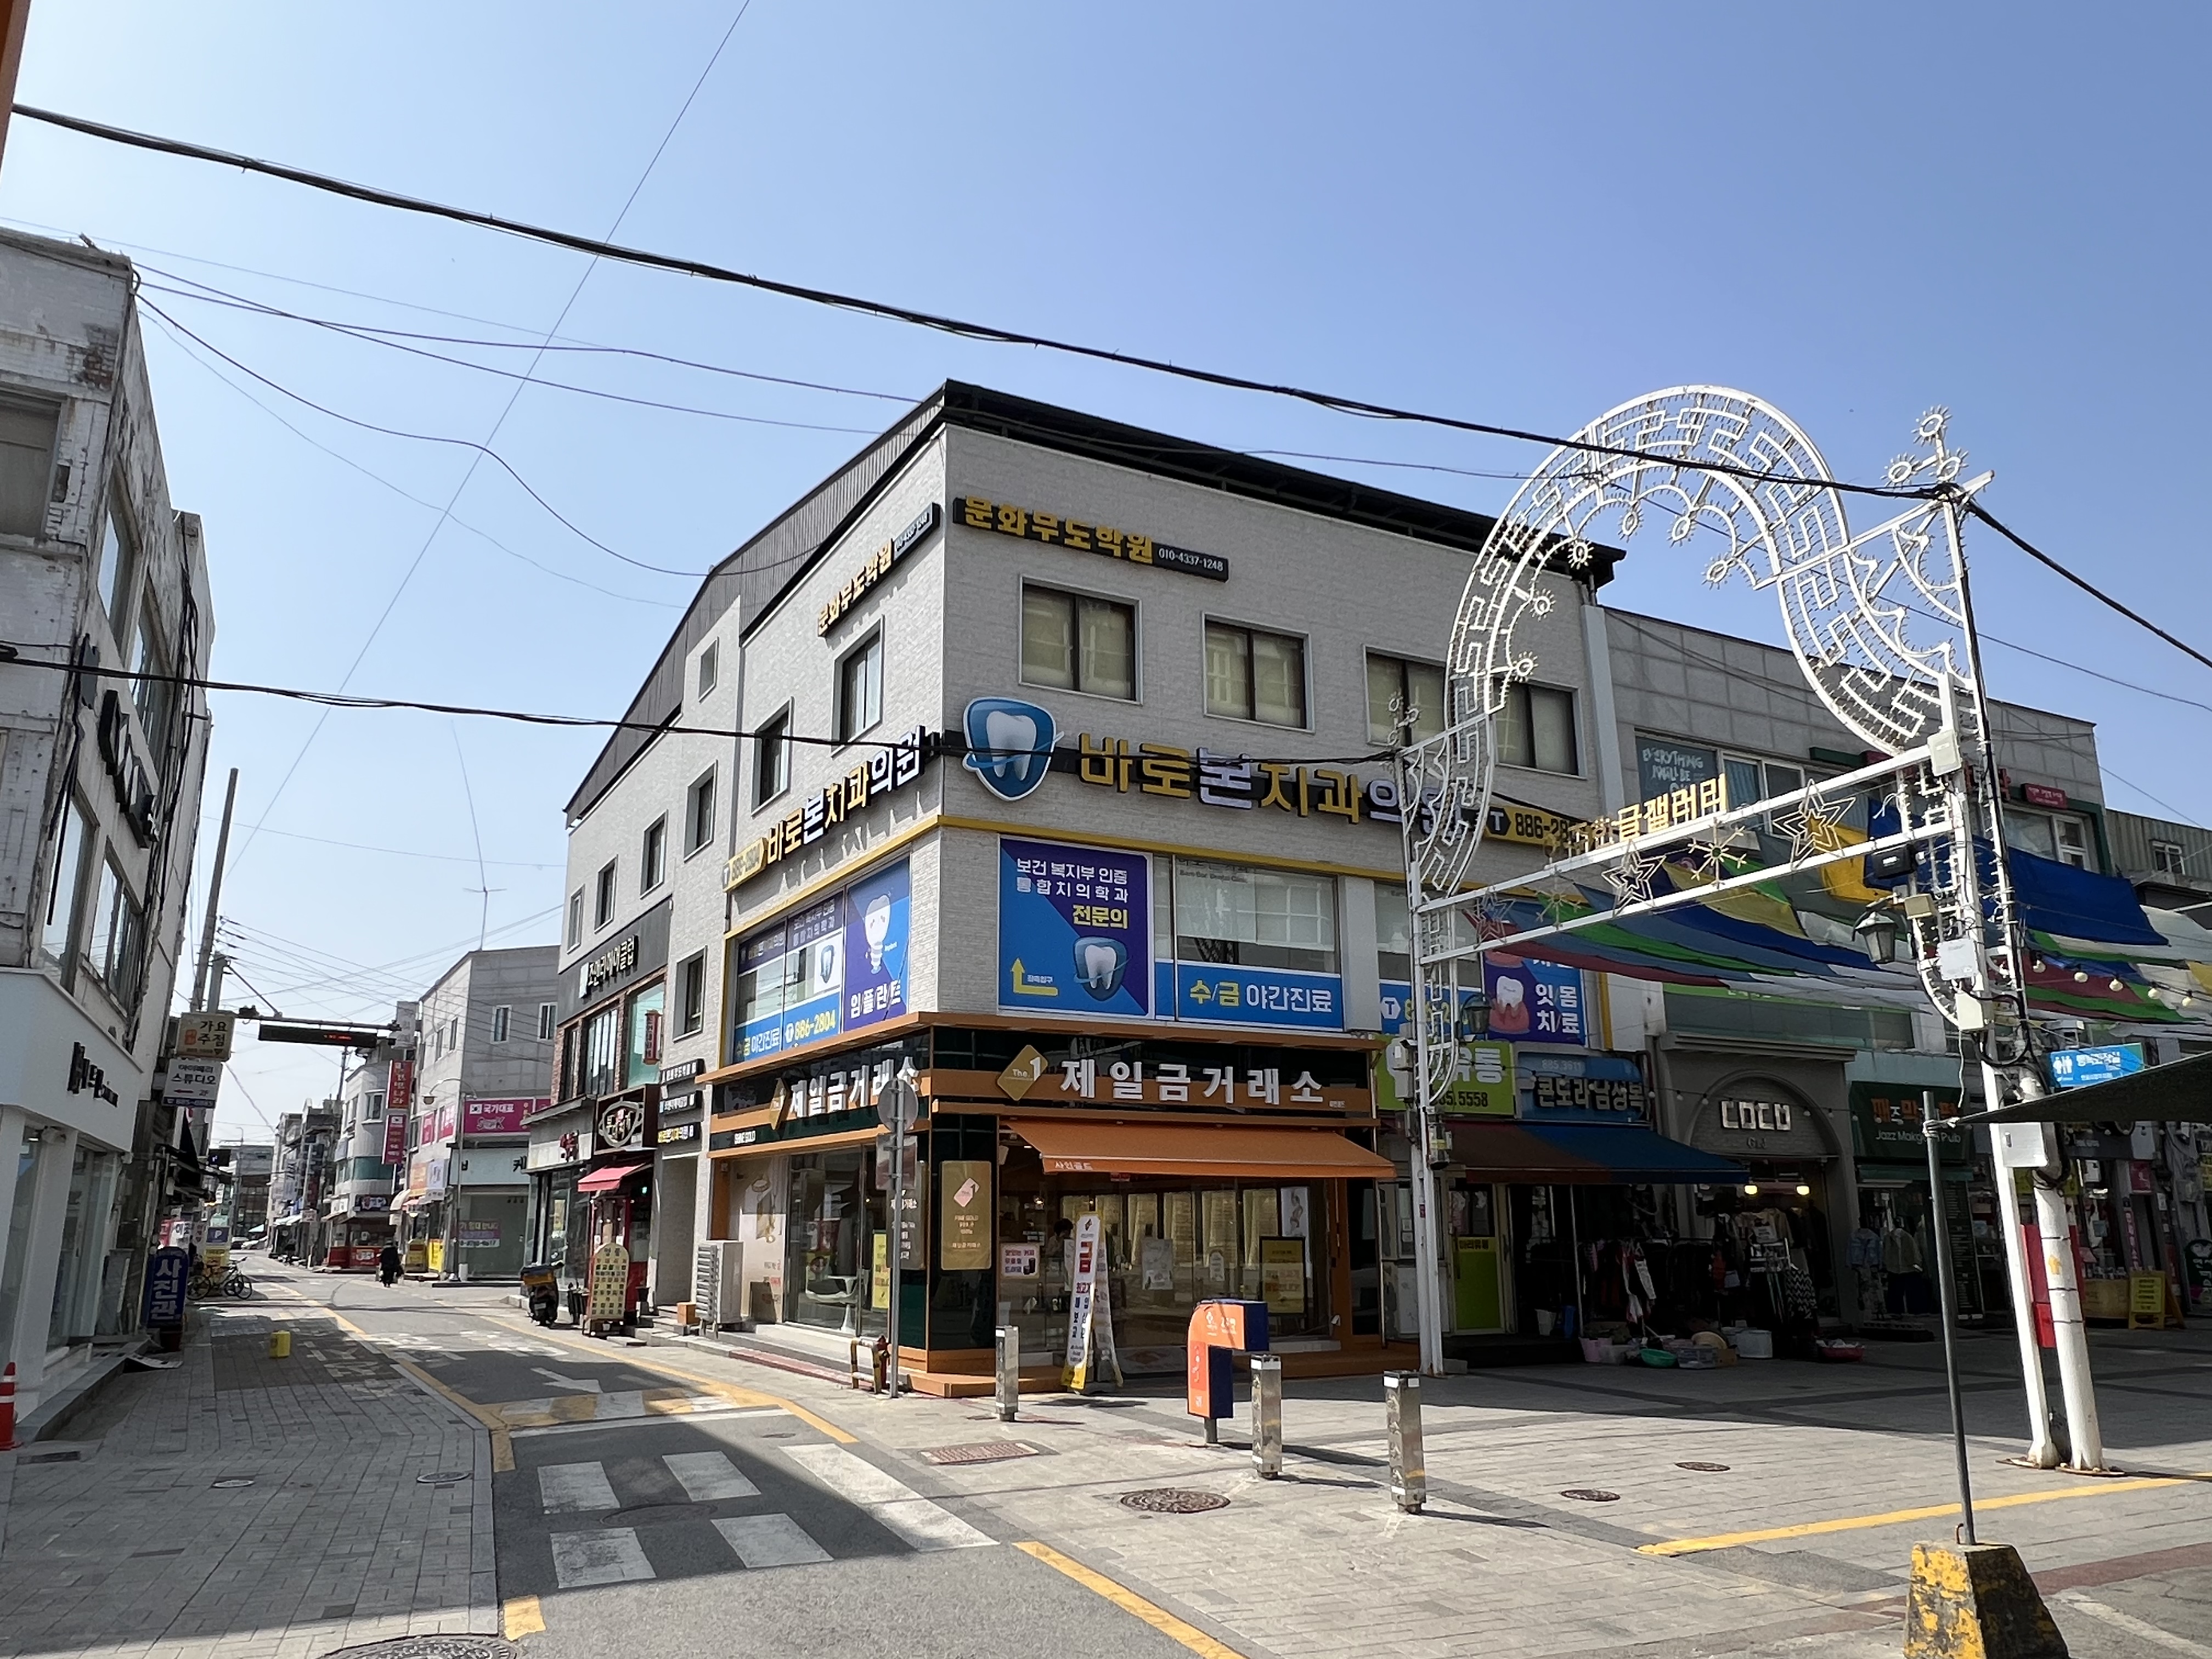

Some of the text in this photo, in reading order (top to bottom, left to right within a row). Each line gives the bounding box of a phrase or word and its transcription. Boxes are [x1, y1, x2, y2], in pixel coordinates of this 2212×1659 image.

[965, 496, 1153, 563] 문화무도학원
[1159, 546, 1223, 572] 010-4337-1248
[768, 725, 926, 865] 바로본치과의원
[1017, 858, 1127, 885] 보건 복지부 인증
[1073, 904, 1128, 929] 전문의
[851, 980, 901, 1018] 임플란트
[1246, 984, 1333, 1013] 야간진료
[198, 1033, 225, 1047] 주점
[200, 1020, 228, 1032] 가요
[1060, 1058, 1324, 1104] 제일금거래소
[1722, 1101, 1791, 1130] COCO
[1940, 1132, 1961, 1143] Pub
[150, 1258, 182, 1320] 사진관
